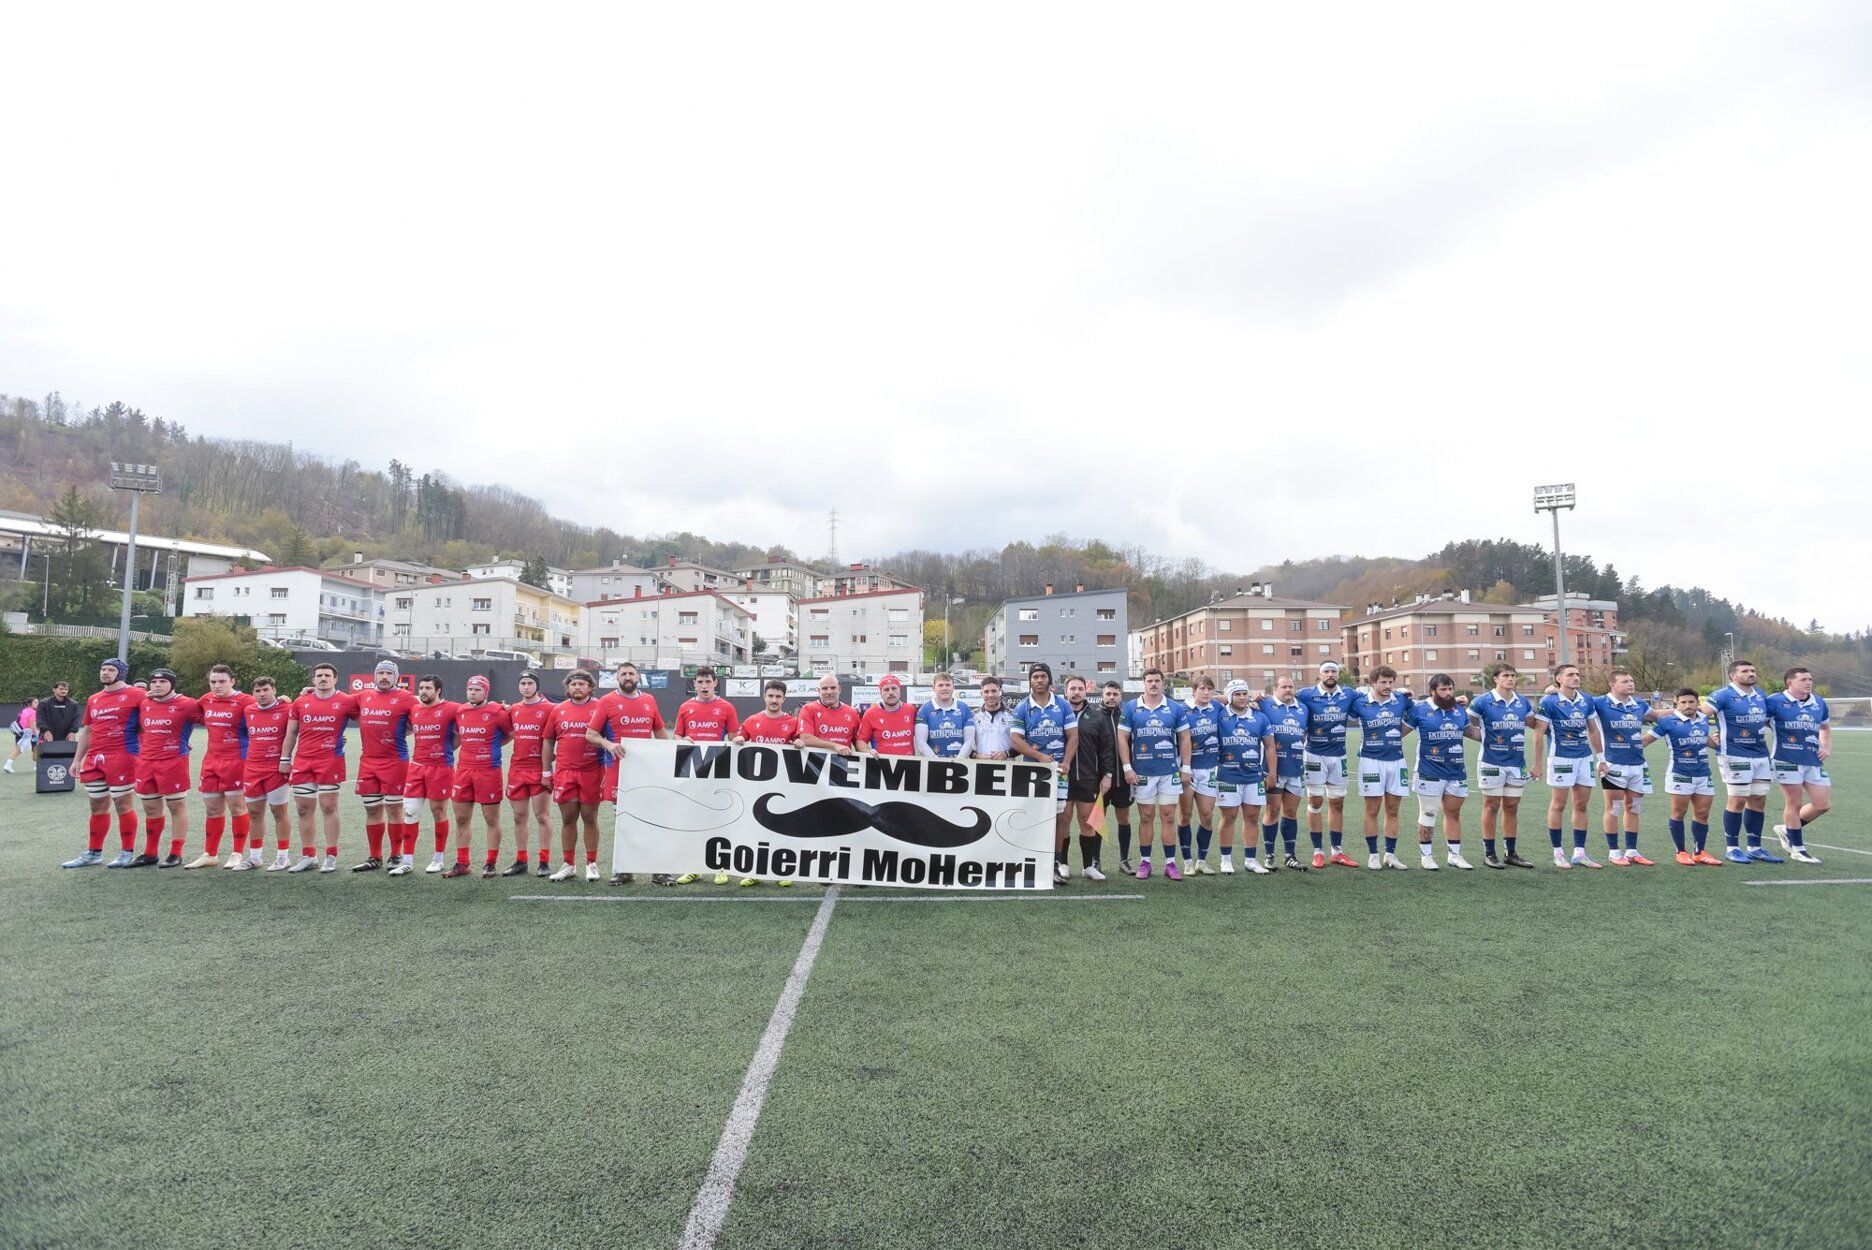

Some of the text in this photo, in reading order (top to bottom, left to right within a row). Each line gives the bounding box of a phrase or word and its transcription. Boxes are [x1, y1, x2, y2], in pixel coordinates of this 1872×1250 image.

[891, 730, 912, 738] AMPO
[673, 745, 1052, 798] MOVEMBER
[705, 836, 1036, 888] Goierri MoHerri
